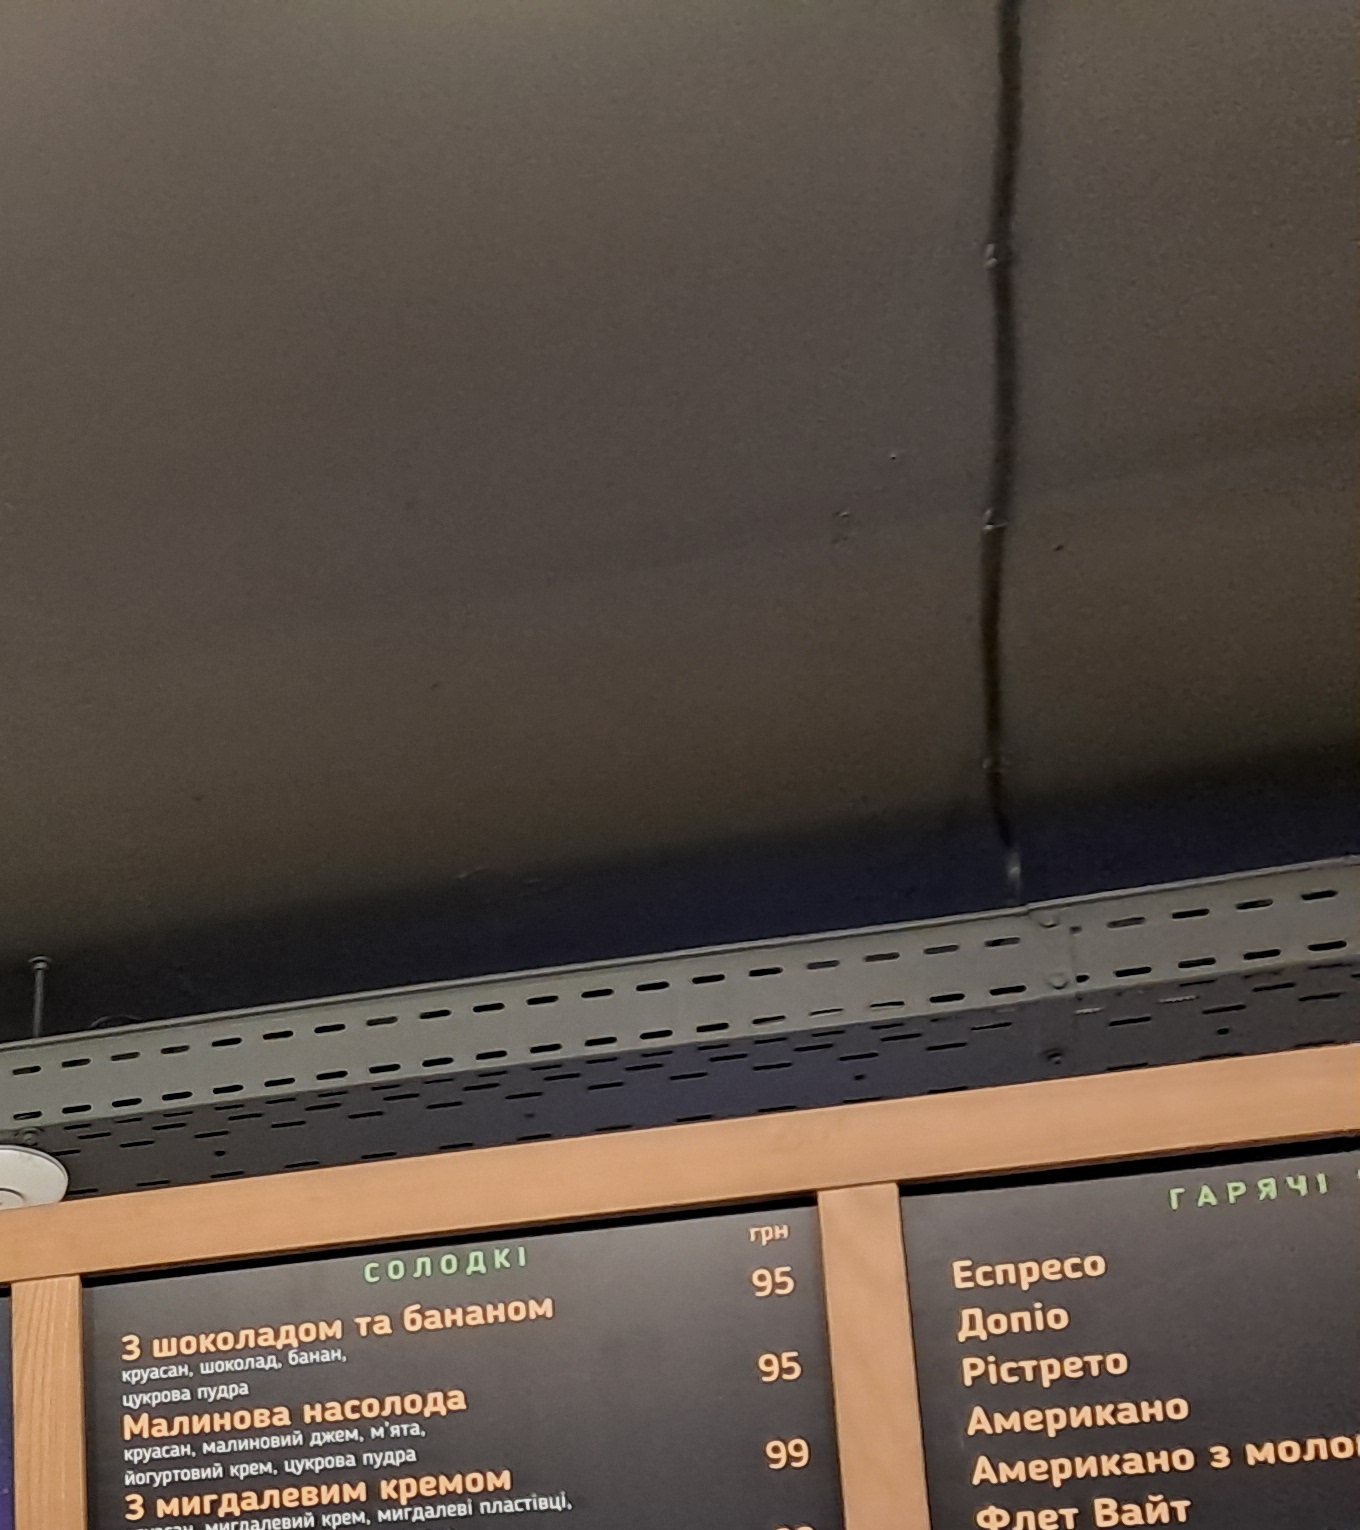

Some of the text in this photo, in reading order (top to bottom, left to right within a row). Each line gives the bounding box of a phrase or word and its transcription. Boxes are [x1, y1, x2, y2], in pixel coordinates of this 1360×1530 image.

[1169, 1172, 1327, 1210] ГАРЯЧІ
[749, 1224, 789, 1246] грн
[364, 1246, 526, 1283] СОЛОДКІ
[752, 1265, 795, 1297] 95
[952, 1255, 1106, 1291] Еспресо
[152, 1319, 342, 1358] шоколадом
[354, 1314, 393, 1337] та
[403, 1297, 553, 1332] бананом
[121, 1348, 347, 1385] круасан, шоколад, банан,
[758, 1351, 802, 1382] 95
[122, 1382, 249, 1410] цукрова пудра
[123, 1389, 467, 1441] Малинова насолода
[967, 1397, 1189, 1438] Американо
[124, 1448, 417, 1488] йогуртовий крем, цукрова пудра
[765, 1438, 809, 1469] 99
[156, 1481, 367, 1518] мигдалевим
[380, 1469, 511, 1506] кремом
[1093, 1494, 1192, 1528] Вайт
